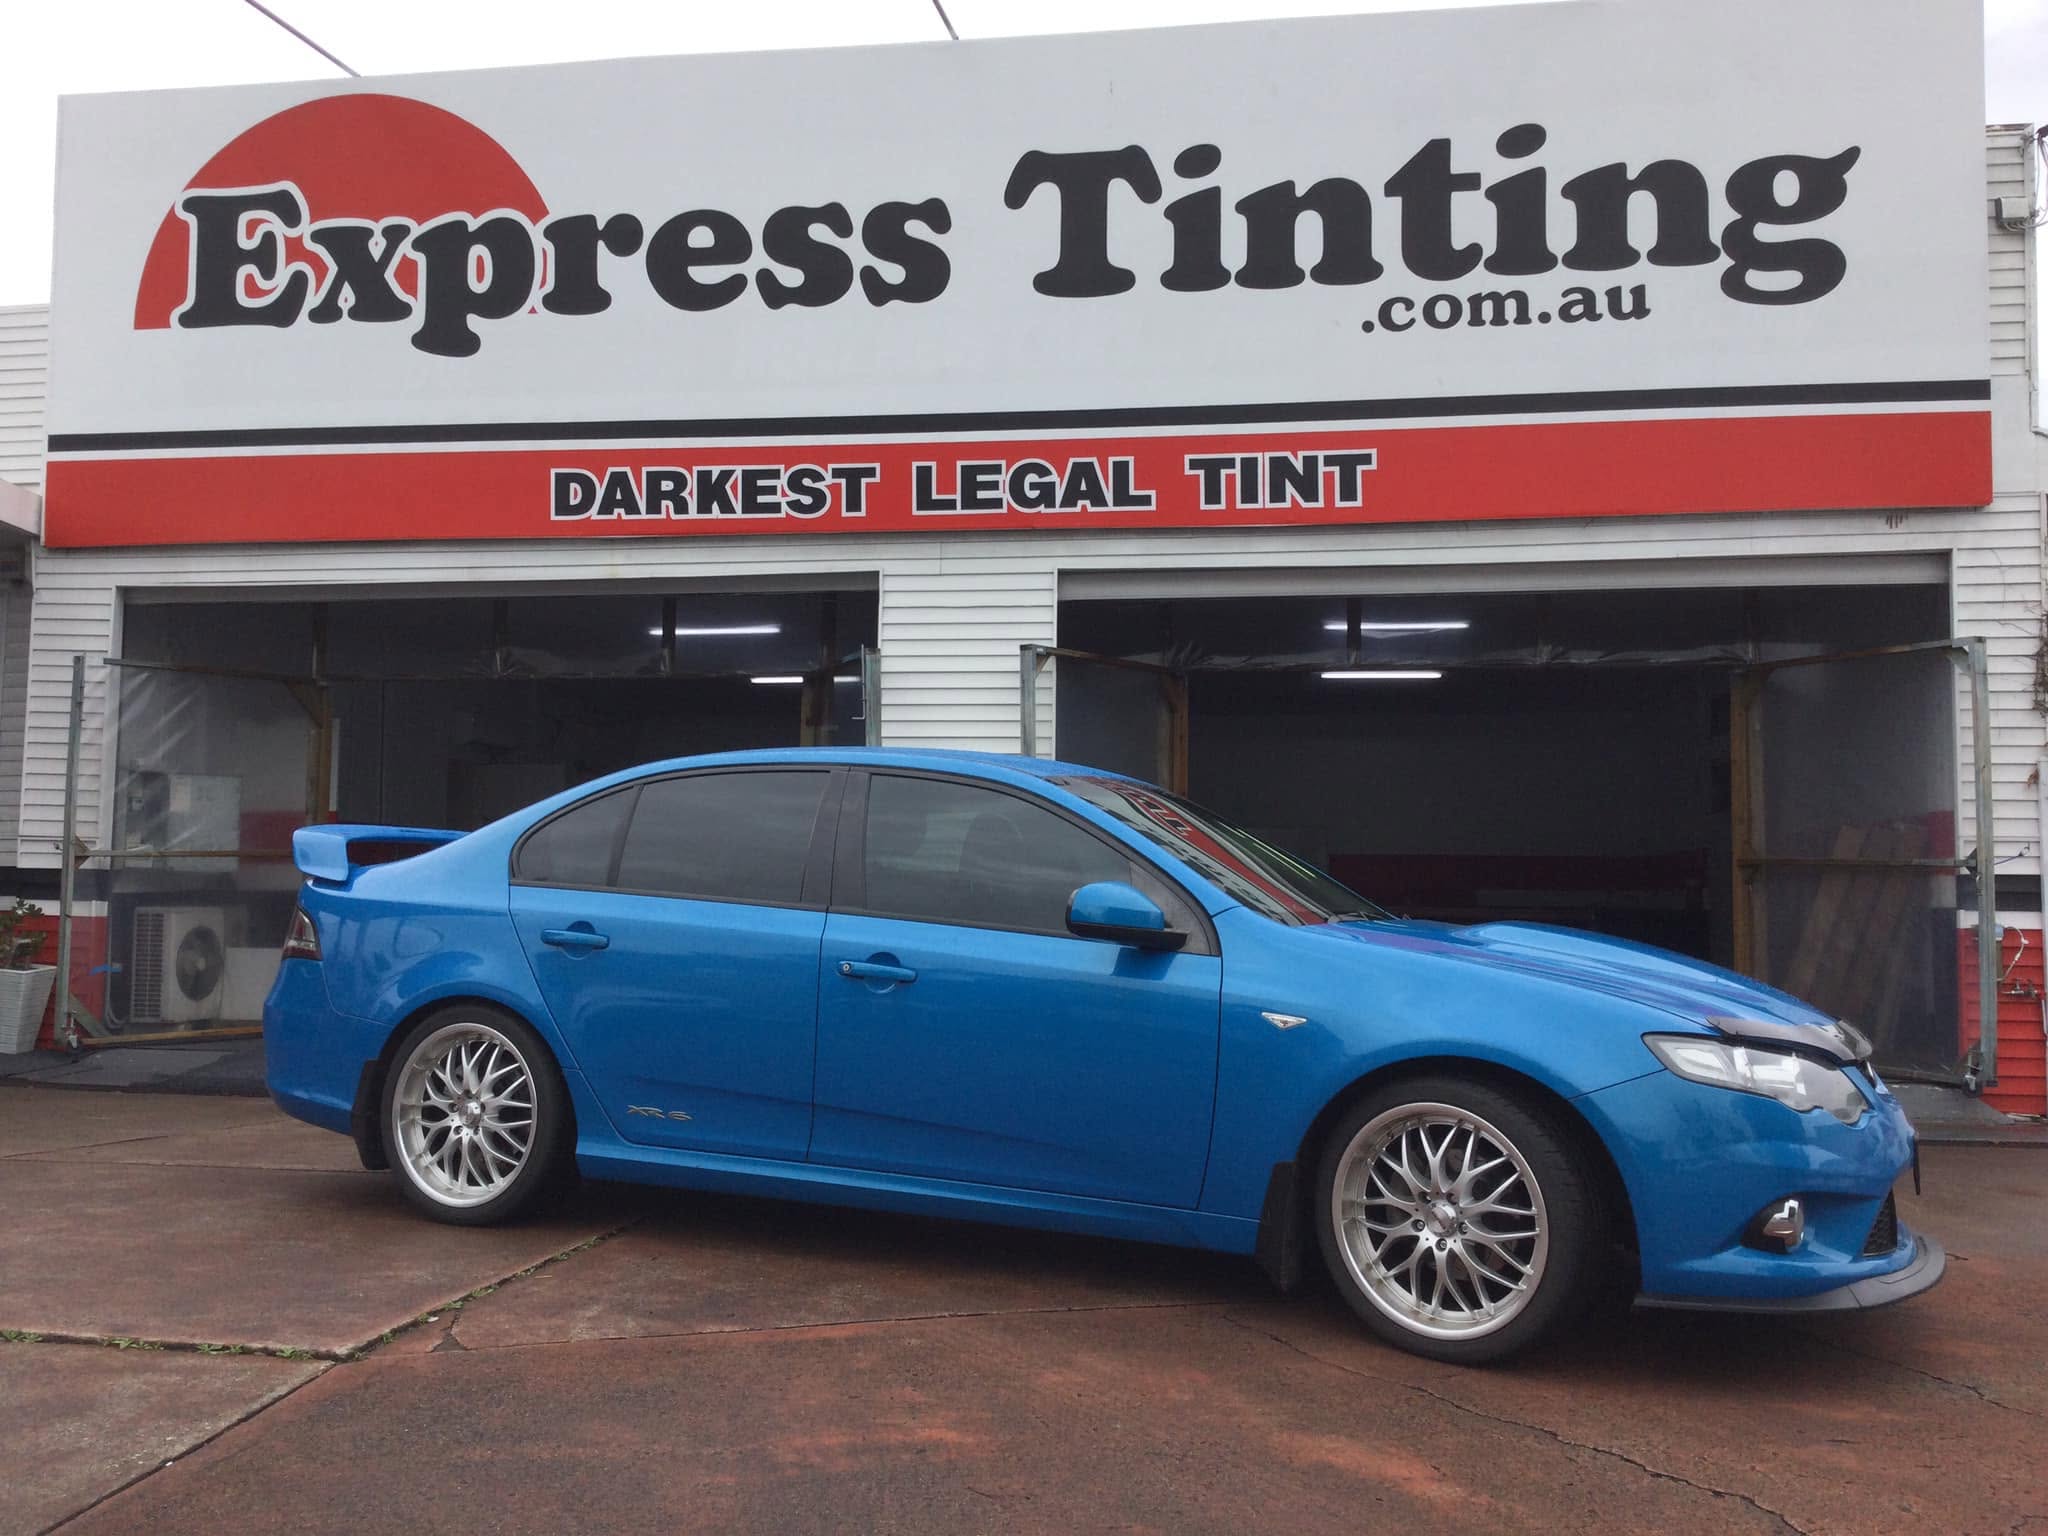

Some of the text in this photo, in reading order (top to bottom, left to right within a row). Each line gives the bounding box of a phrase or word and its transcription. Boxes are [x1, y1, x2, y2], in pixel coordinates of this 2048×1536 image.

[178, 122, 1861, 358] Express Tinting
[1361, 283, 1651, 333] .com.au
[551, 448, 1377, 520] DARKEST LEGAL TINT
